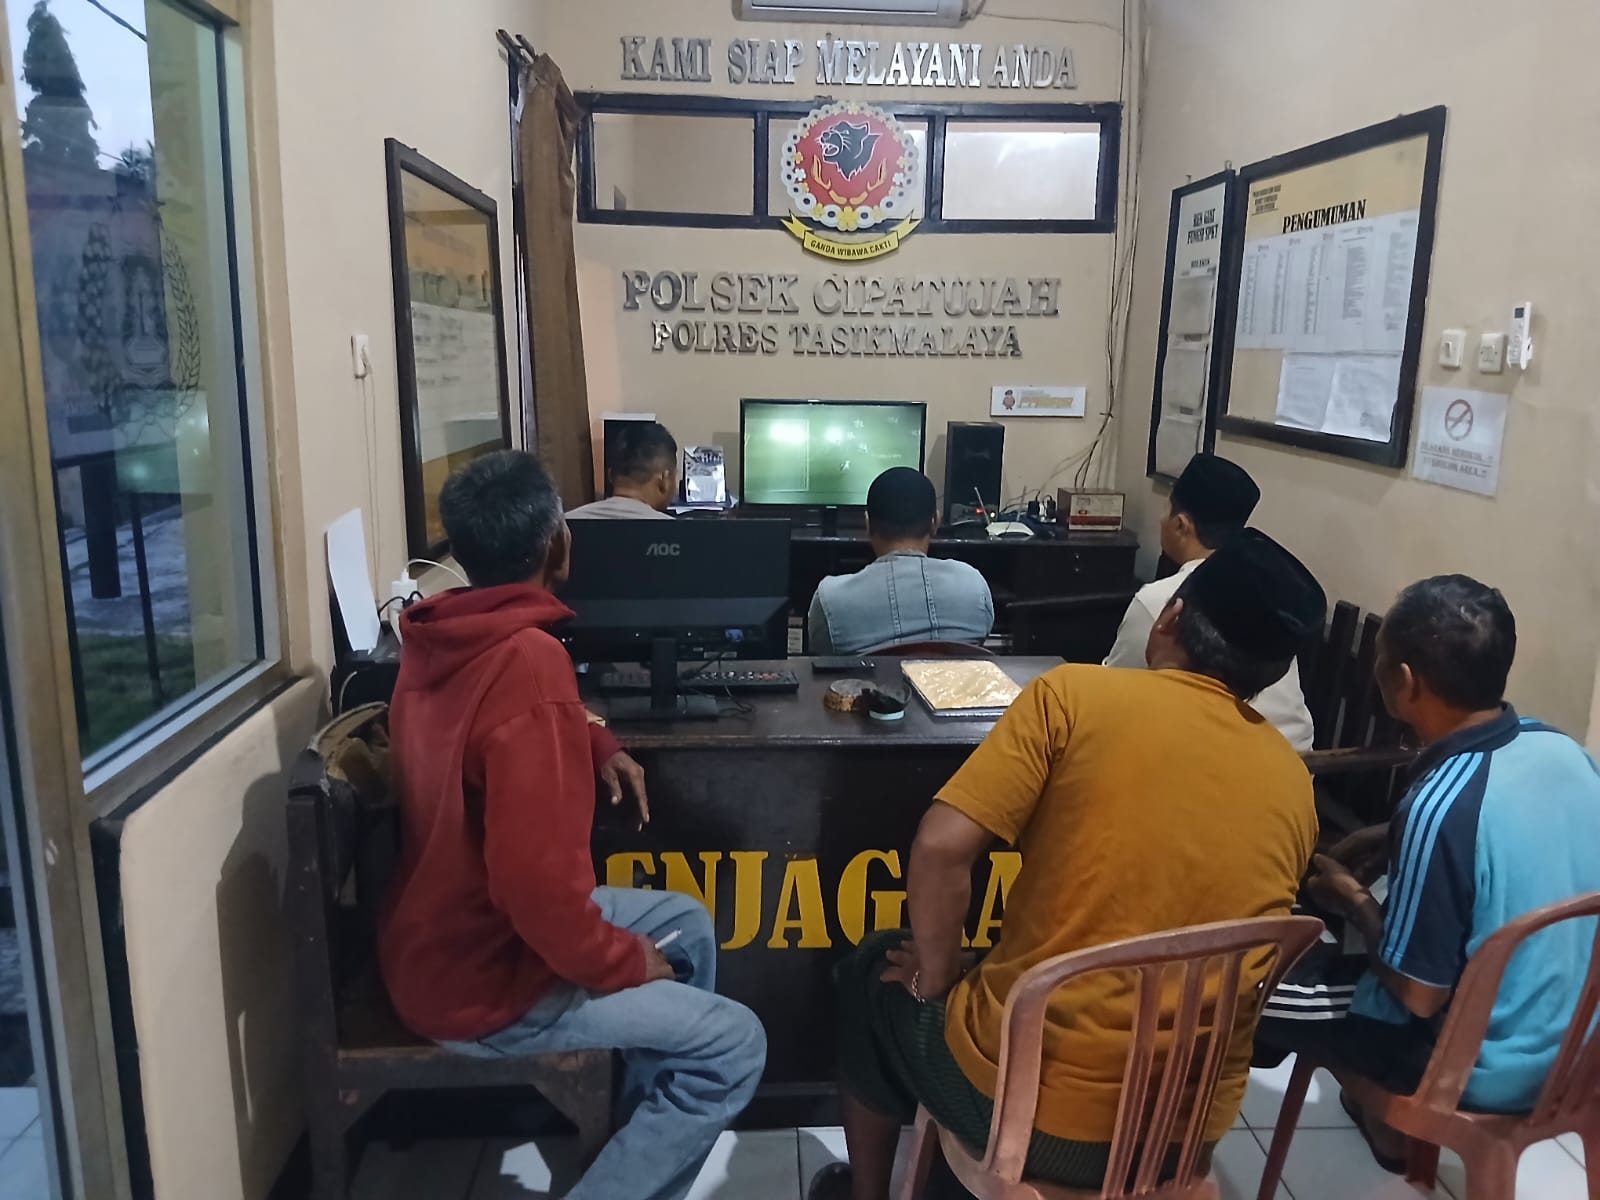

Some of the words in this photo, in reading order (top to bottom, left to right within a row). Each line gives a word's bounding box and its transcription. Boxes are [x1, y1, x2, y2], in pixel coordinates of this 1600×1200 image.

[620, 36, 712, 83] KAMI
[727, 38, 804, 84] SIAP
[815, 39, 982, 87] MELAYANI
[987, 43, 1078, 89] ANDA
[1282, 198, 1368, 235] PENGUMUMAN
[810, 240, 835, 255] GANDA
[837, 247, 869, 257] WIBAWA
[869, 240, 892, 254] CAKTI
[622, 270, 800, 314] POLSEK
[813, 274, 1062, 317] CIPATUJAH
[652, 320, 780, 355] POLRES
[788, 322, 1022, 358] TASIKMALAYA
[645, 543, 681, 556] AOC
